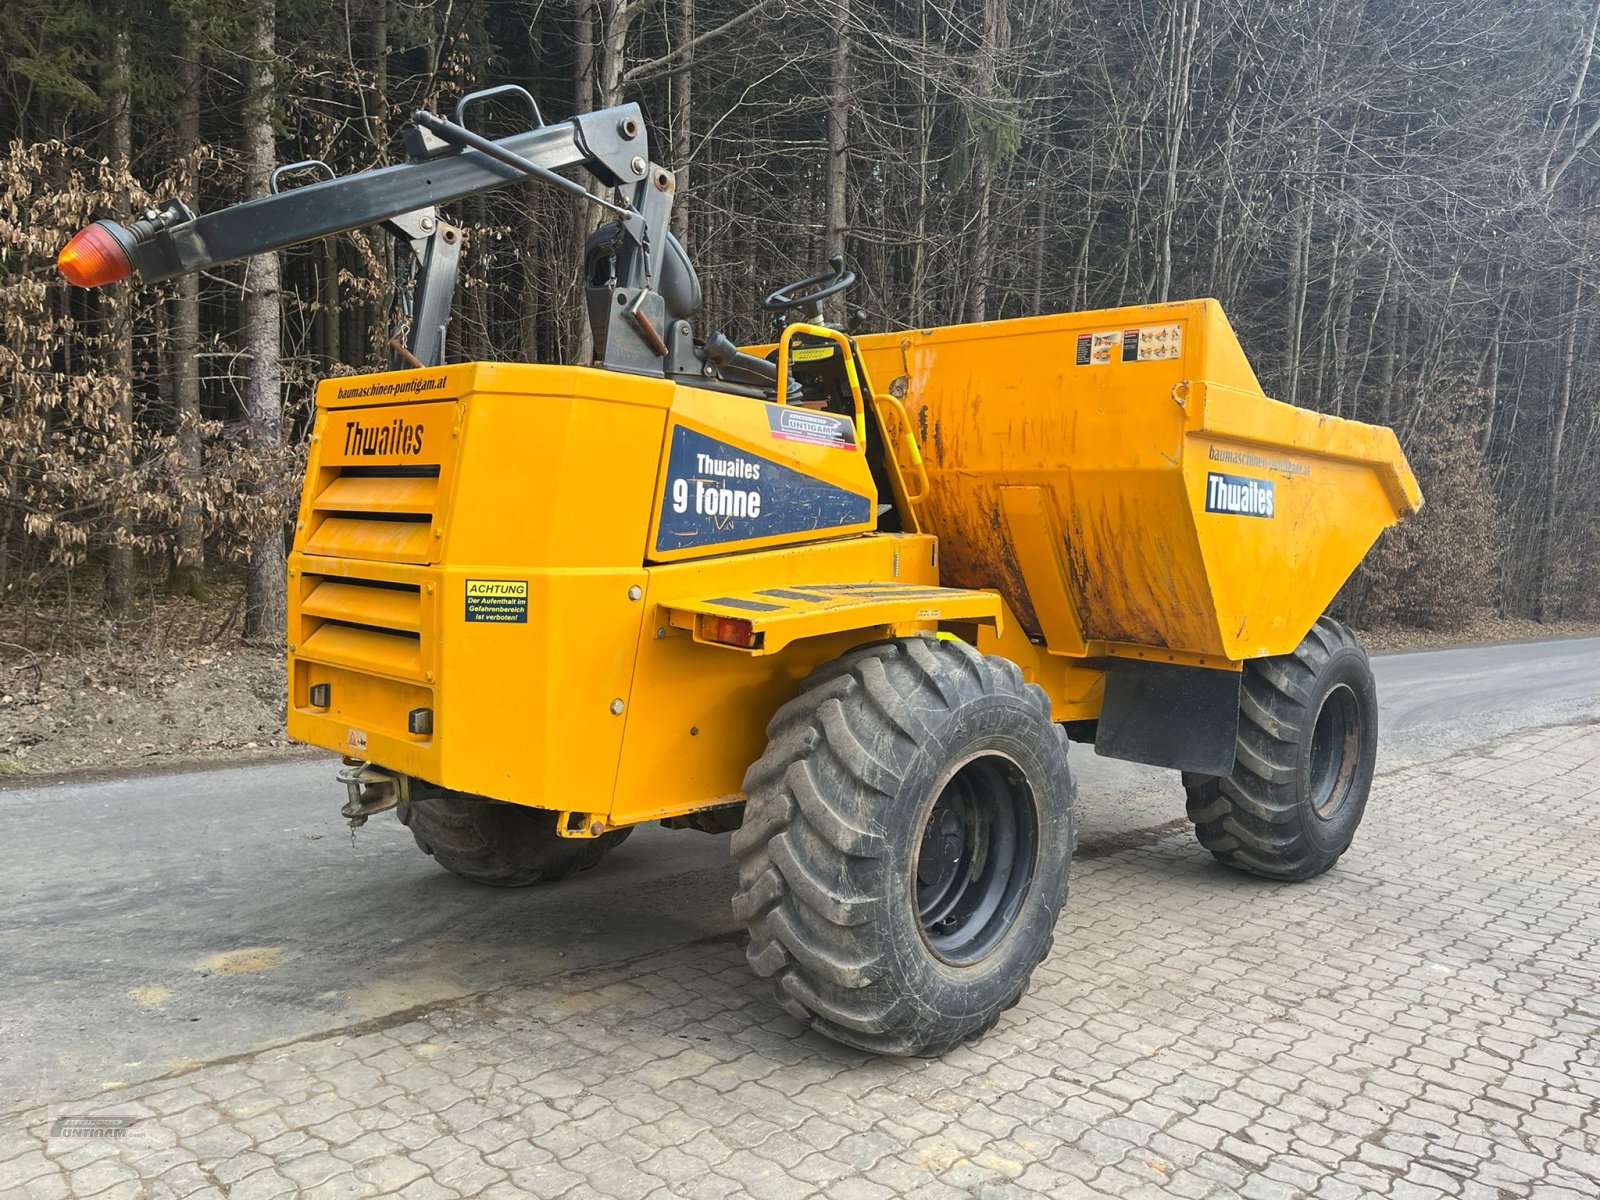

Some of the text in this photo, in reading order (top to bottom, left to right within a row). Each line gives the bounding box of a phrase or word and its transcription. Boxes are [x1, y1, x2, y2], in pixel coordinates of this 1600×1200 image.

[337, 375, 447, 400] baumaschinen-puntigam.at
[344, 419, 424, 456] Thwaites
[696, 453, 761, 480] Thwaites
[672, 478, 689, 514] 9
[1209, 474, 1273, 516] Thwaites
[469, 584, 525, 594] ACHTUNG
[481, 597, 516, 605] Aufenthalt
[469, 605, 525, 613] Gefahrenbereich
